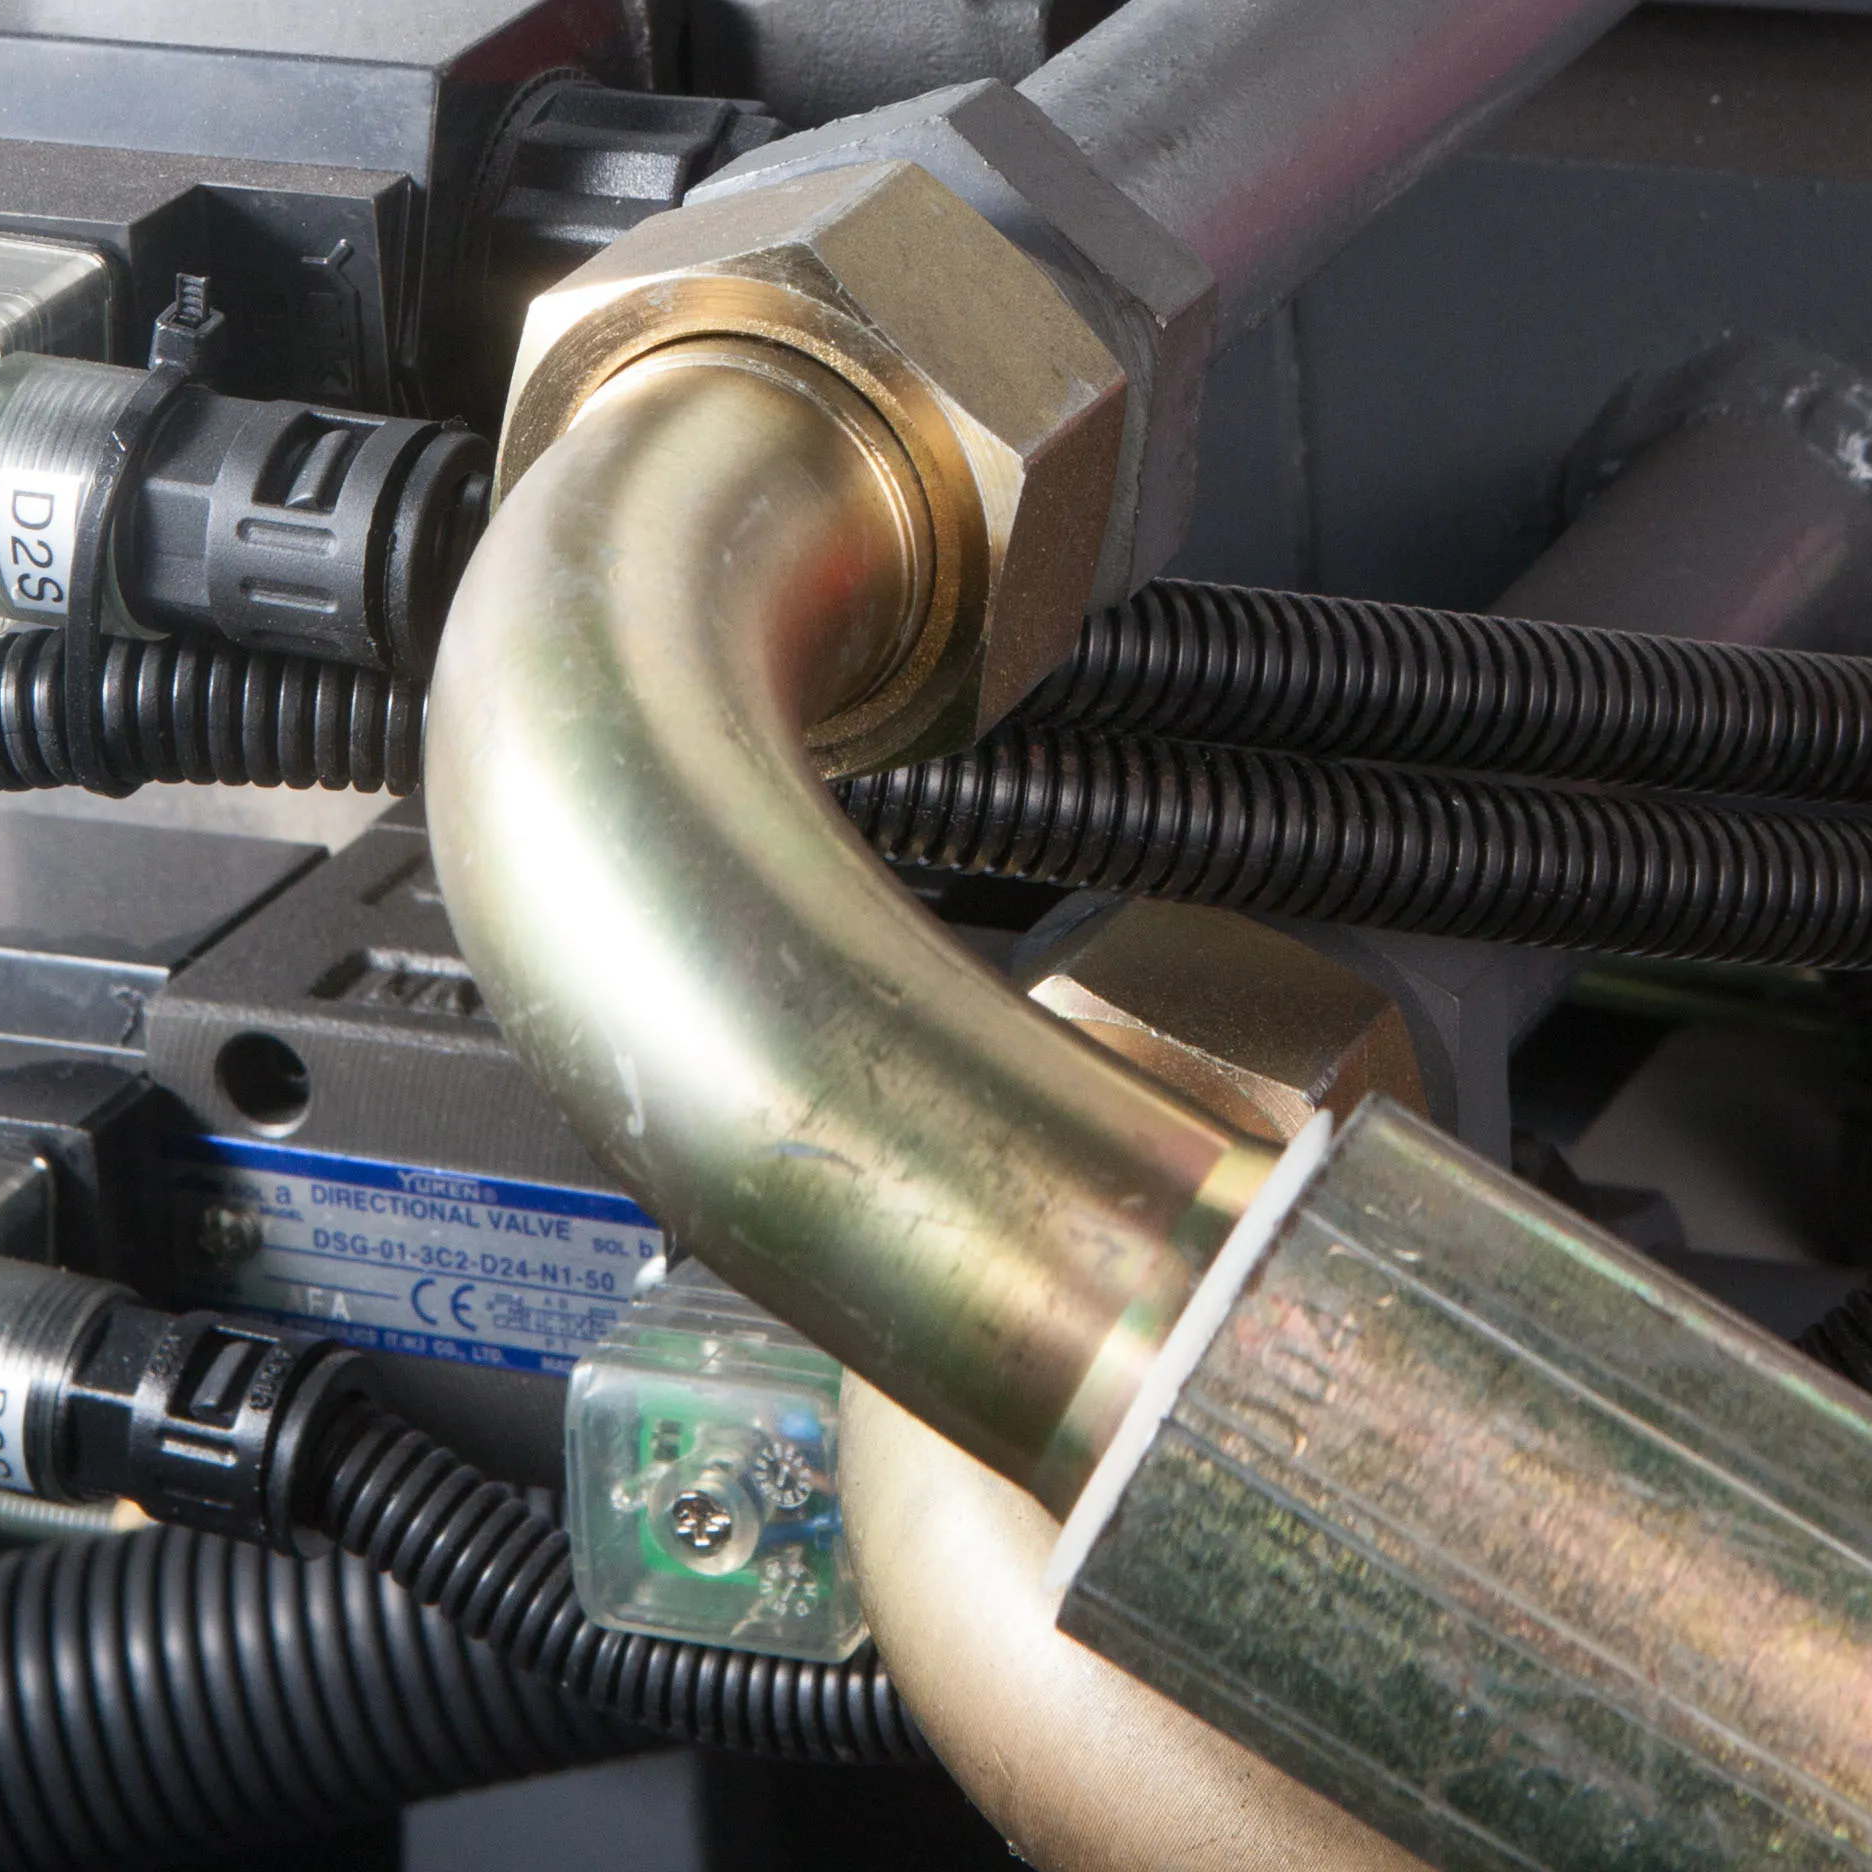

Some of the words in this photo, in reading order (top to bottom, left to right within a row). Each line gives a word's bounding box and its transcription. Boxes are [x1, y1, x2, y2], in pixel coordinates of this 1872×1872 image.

[9, 489, 66, 606] D2S
[311, 1184, 480, 1229] DIRECTIONAL
[488, 1210, 571, 1241] VALVE
